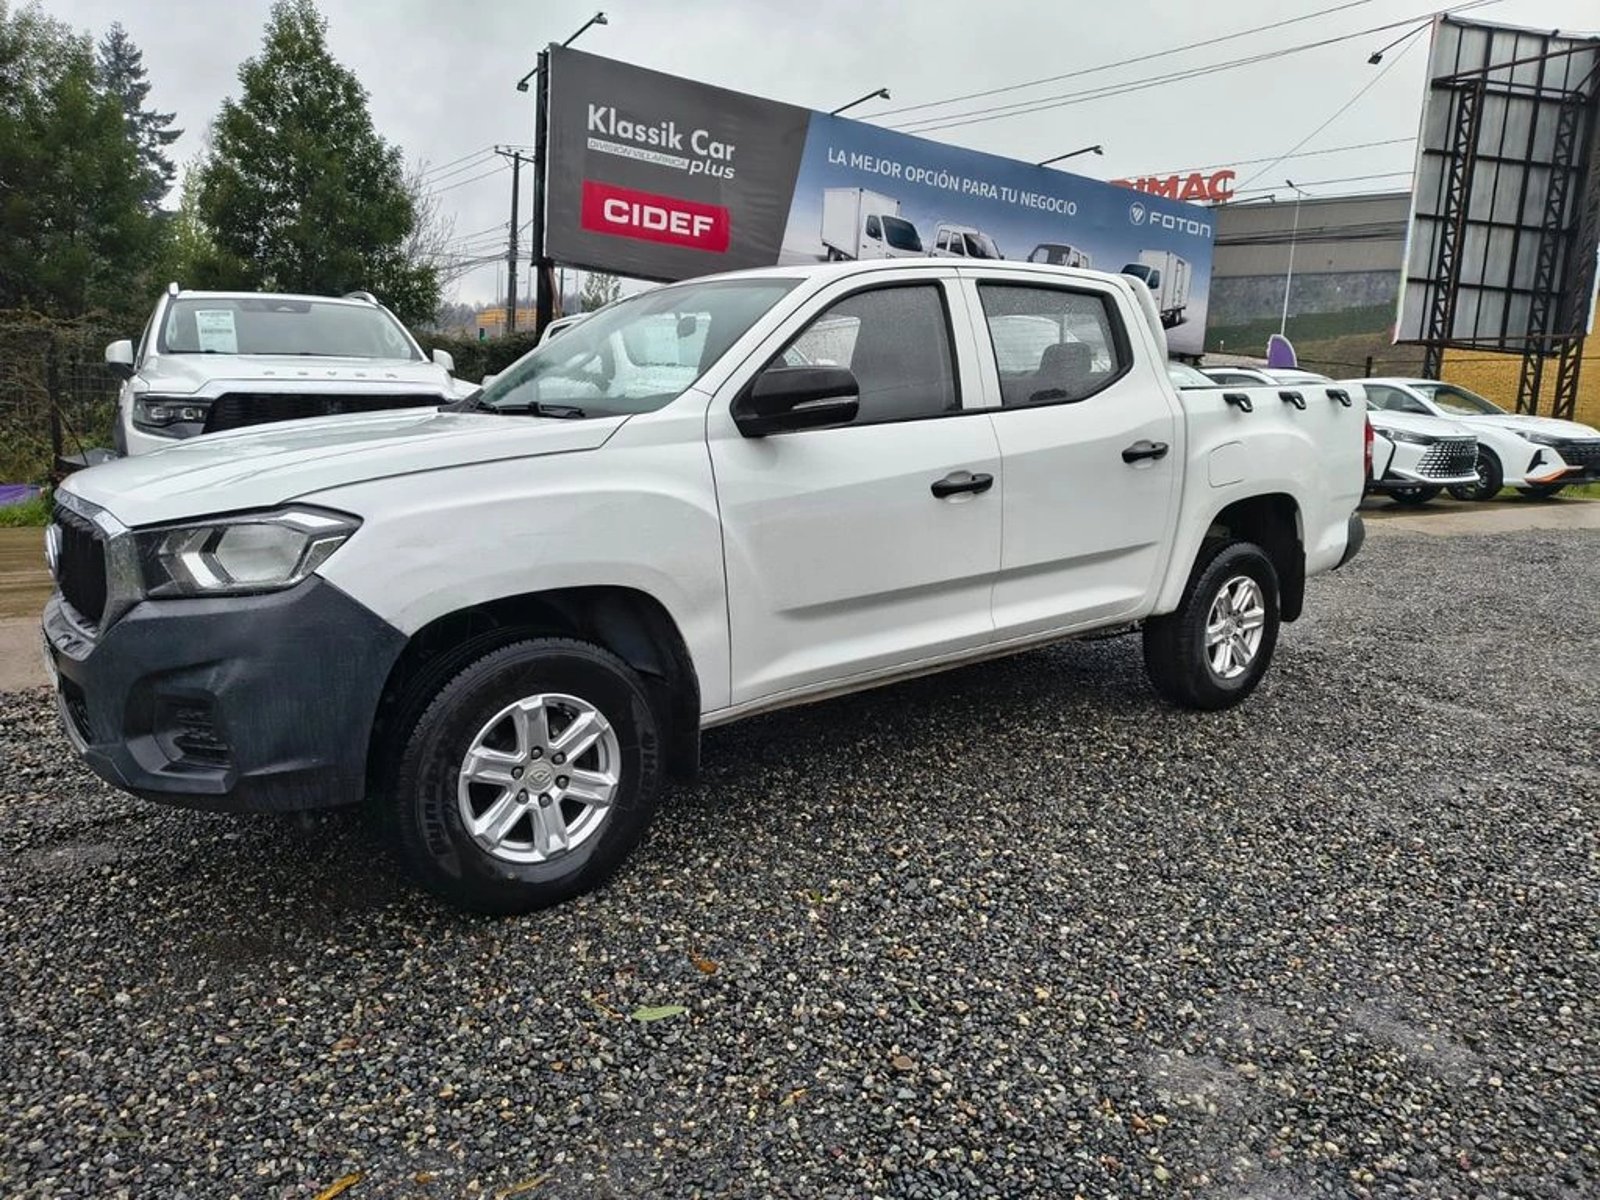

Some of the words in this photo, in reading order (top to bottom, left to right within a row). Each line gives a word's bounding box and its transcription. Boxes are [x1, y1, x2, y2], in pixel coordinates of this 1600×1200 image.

[587, 103, 683, 150] Klassik
[691, 129, 735, 160] Car
[689, 159, 735, 179] plus
[828, 147, 847, 166] LA
[850, 152, 902, 178] MEJOR
[905, 165, 959, 191] OPCIÓN
[962, 179, 998, 199] PARA
[1000, 186, 1018, 203] TU
[1020, 191, 1077, 216] NEGOCIO
[603, 198, 714, 237] CIDEF
[1149, 211, 1211, 238] FOTON
